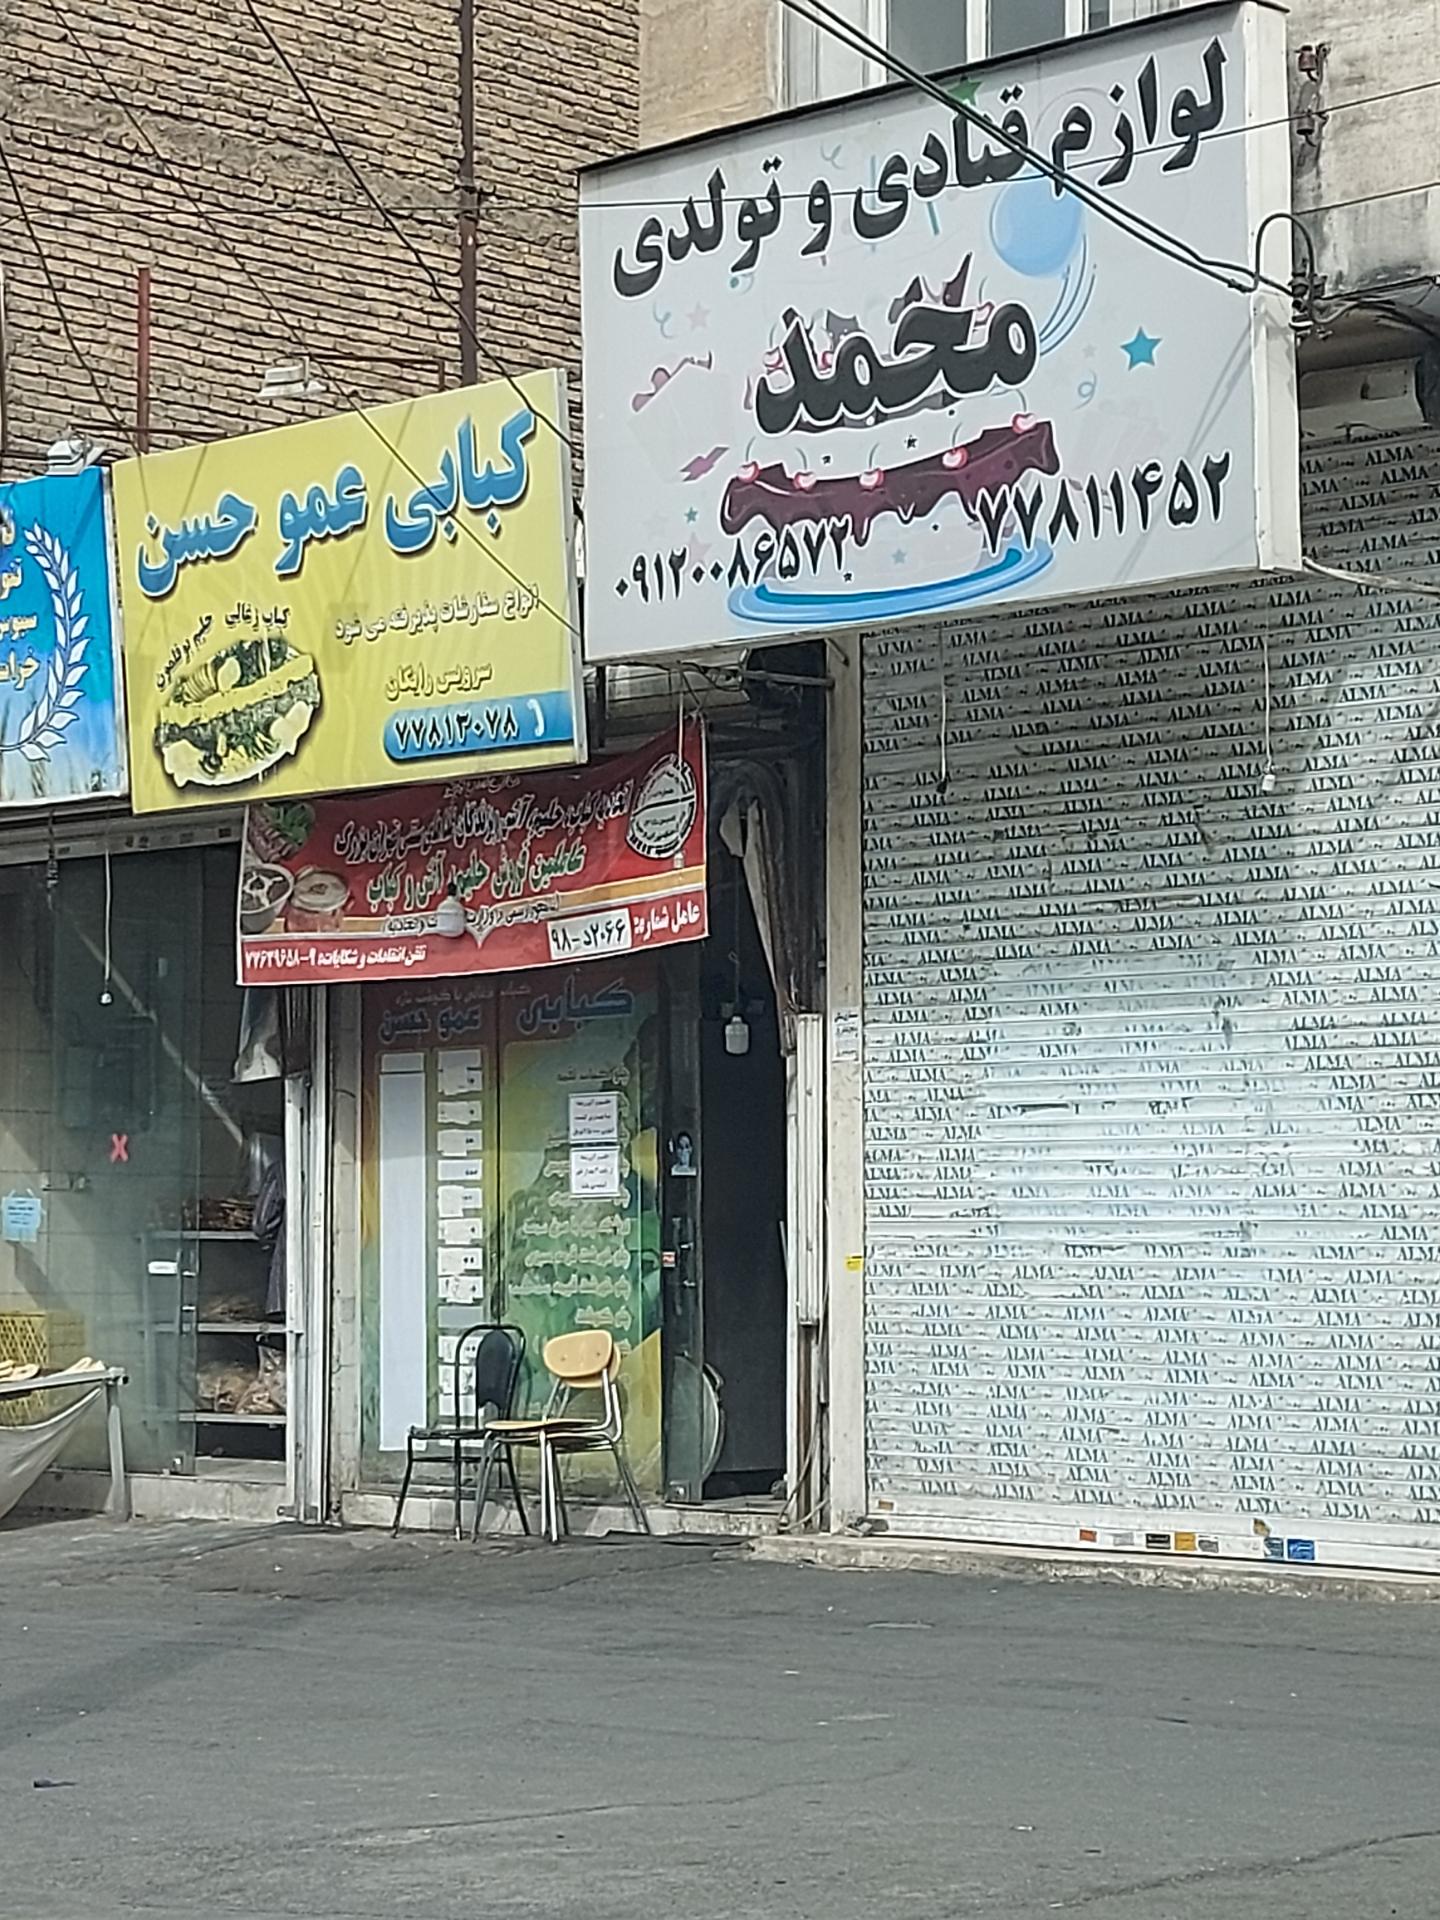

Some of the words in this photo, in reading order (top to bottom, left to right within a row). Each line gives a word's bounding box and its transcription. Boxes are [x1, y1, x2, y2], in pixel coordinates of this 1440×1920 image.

[1052, 37, 1228, 193] لوازم
[854, 87, 1026, 239] قنادی
[802, 181, 830, 256] و
[614, 157, 783, 296] تولدی
[385, 411, 535, 552] کبابی
[1381, 464, 1428, 484] ALMA
[977, 452, 1231, 555] ۷۷۸۱۱۴۵۲
[1340, 491, 1392, 511] ALMA
[274, 465, 367, 574] عمو
[138, 493, 256, 597] حسن
[1360, 534, 1406, 552] ALMA
[440, 592, 499, 626] سفارشات
[503, 583, 539, 620] انواع
[1365, 599, 1411, 617] ALMA
[389, 603, 438, 633] پذیرفته
[1104, 611, 1142, 626] ALMA
[1282, 610, 1322, 627] ALMA
[335, 613, 362, 645] شود
[1024, 621, 1062, 636] ALMA
[1198, 620, 1237, 637] ALMA
[951, 631, 986, 646] ALMA
[1138, 646, 1179, 663] ALMA
[891, 659, 925, 674] ALMA
[981, 666, 1019, 681] ALMA
[386, 662, 434, 700] رایگان
[437, 663, 492, 695] سرویس
[1204, 679, 1244, 695] ALMA
[1123, 689, 1160, 703] ALMA
[1043, 698, 1080, 712] ALMA
[967, 706, 1003, 721] ALMA
[1090, 713, 1128, 727] ALMA
[394, 703, 518, 752] ۷۷۸۱۳۰۷۸
[894, 715, 928, 730] ALMA
[1012, 721, 1048, 735] ALMA
[1286, 713, 1330, 730] ALMA
[1201, 722, 1242, 737] ALMA
[1136, 770, 1178, 786] ALMA
[1218, 762, 1266, 779] ALMA
[1060, 778, 1097, 792] ALMA
[1312, 775, 1352, 790] ALMA
[984, 786, 1019, 799] ALMA
[912, 812, 949, 825] ALMA
[1336, 816, 1378, 831] ALMA
[1250, 824, 1290, 838] ALMA
[1010, 844, 1045, 857] ALMA
[1087, 837, 1125, 852] ALMA
[1308, 839, 1352, 855] ALMA
[1141, 852, 1182, 867] ALMA
[1222, 846, 1266, 861] ALMA
[1332, 859, 1376, 874] ALMA
[911, 870, 949, 884] ALMA
[1086, 878, 1124, 891] ALMA
[1282, 886, 1324, 900] ALMA
[1368, 879, 1413, 894] ALMA
[1199, 891, 1238, 904] ALMA
[961, 907, 999, 921] ALMA
[1039, 902, 1076, 915] ALMA
[1214, 910, 1257, 924] ALMA
[904, 930, 939, 943] ALMA
[1318, 924, 1364, 940] ALMA
[1071, 939, 1110, 954] ALMA
[1152, 935, 1192, 949] ALMA
[995, 944, 1032, 958] ALMA
[938, 967, 975, 981] ALMA
[1266, 970, 1311, 986] ALMA
[1354, 966, 1400, 982] ALMA
[878, 991, 912, 1005] ALMA
[438, 1003, 482, 1041] عمو
[1294, 1015, 1334, 1029] ALMA
[1374, 1031, 1416, 1045] ALMA
[890, 1049, 925, 1062] ALMA
[924, 1087, 963, 1101] ALMA
[871, 1126, 906, 1139] ALMA
[1340, 1161, 1382, 1175] ALMA
[934, 1186, 972, 1198] ALMA
[1255, 1184, 1295, 1196] ALMA
[1381, 1226, 1427, 1240] ALMA
[1012, 1265, 1053, 1278] ALMA
[1090, 1266, 1132, 1279] ALMA
[910, 1282, 947, 1294] ALMA
[1142, 1286, 1183, 1298] ALMA
[1311, 1288, 1356, 1302] ALMA
[924, 1323, 960, 1336] ALMA
[997, 1325, 1037, 1339] ALMA
[1075, 1327, 1115, 1340] ALMA
[1240, 1332, 1284, 1346] ALMA
[1163, 1350, 1206, 1364] ALMA
[932, 1362, 968, 1375] ALMA
[1082, 1366, 1124, 1380] ALMA
[1339, 1375, 1381, 1389] ALMA
[987, 1404, 1026, 1418] ALMA
[1148, 1411, 1186, 1426] ALMA
[1228, 1414, 1271, 1429] ALMA
[1059, 1427, 1101, 1442] ALMA
[1313, 1440, 1354, 1454] ALMA
[1146, 1452, 1189, 1467] ALMA
[1230, 1456, 1273, 1471] ALMA
[922, 1480, 956, 1493] ALMA
[993, 1484, 1032, 1499] ALMA
[1074, 1489, 1112, 1503] ALMA
[1154, 1494, 1195, 1507] ALMA
[1235, 1497, 1279, 1512] ALMA
[1326, 1503, 1369, 1518] ALMA
